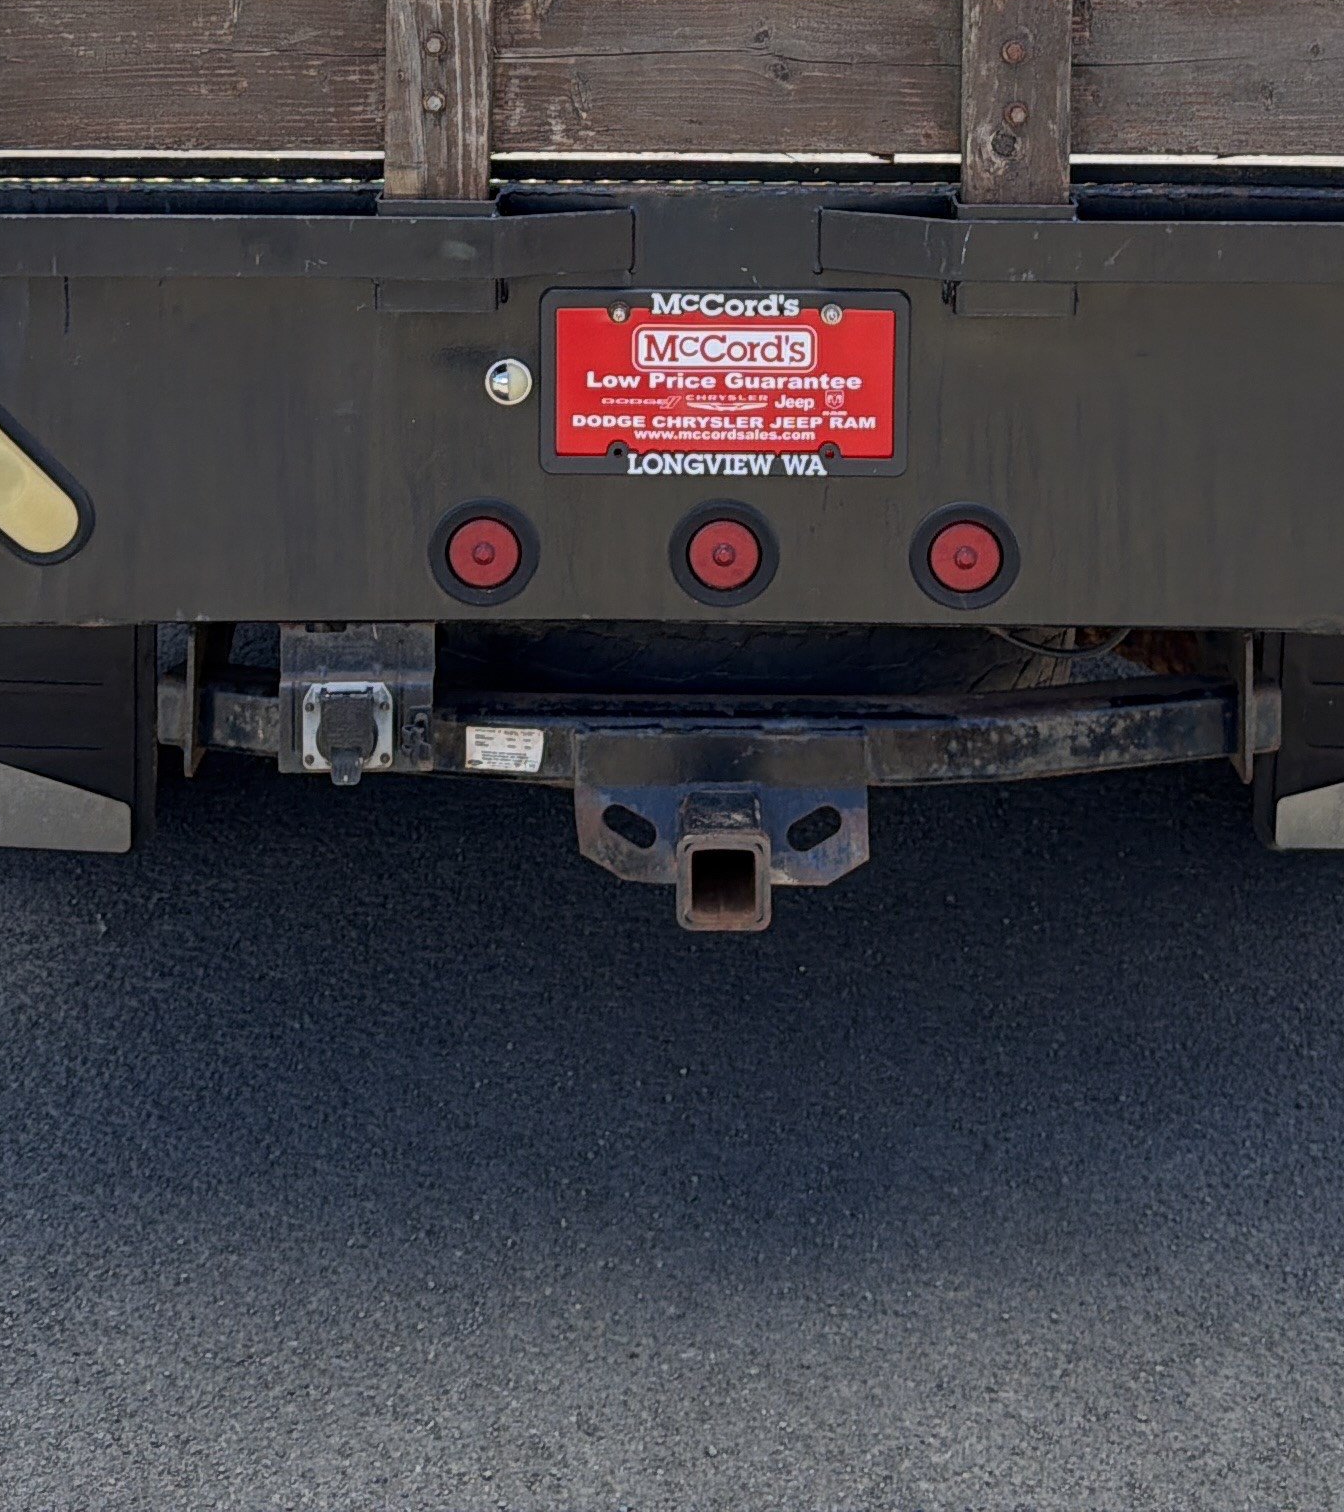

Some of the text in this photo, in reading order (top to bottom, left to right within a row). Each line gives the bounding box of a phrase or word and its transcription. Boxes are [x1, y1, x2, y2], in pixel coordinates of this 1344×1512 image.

[651, 293, 800, 317] McCord's
[643, 333, 806, 364] McCord's
[586, 371, 862, 390] Low Price Guarantee
[685, 394, 768, 402] CHRYSLER
[774, 394, 816, 411] Jeep
[572, 415, 876, 429] DODGE CHRYSLER JEEP RAM
[633, 429, 816, 442] www.mccordsales.com
[627, 453, 828, 476] LONGVIEW WA
